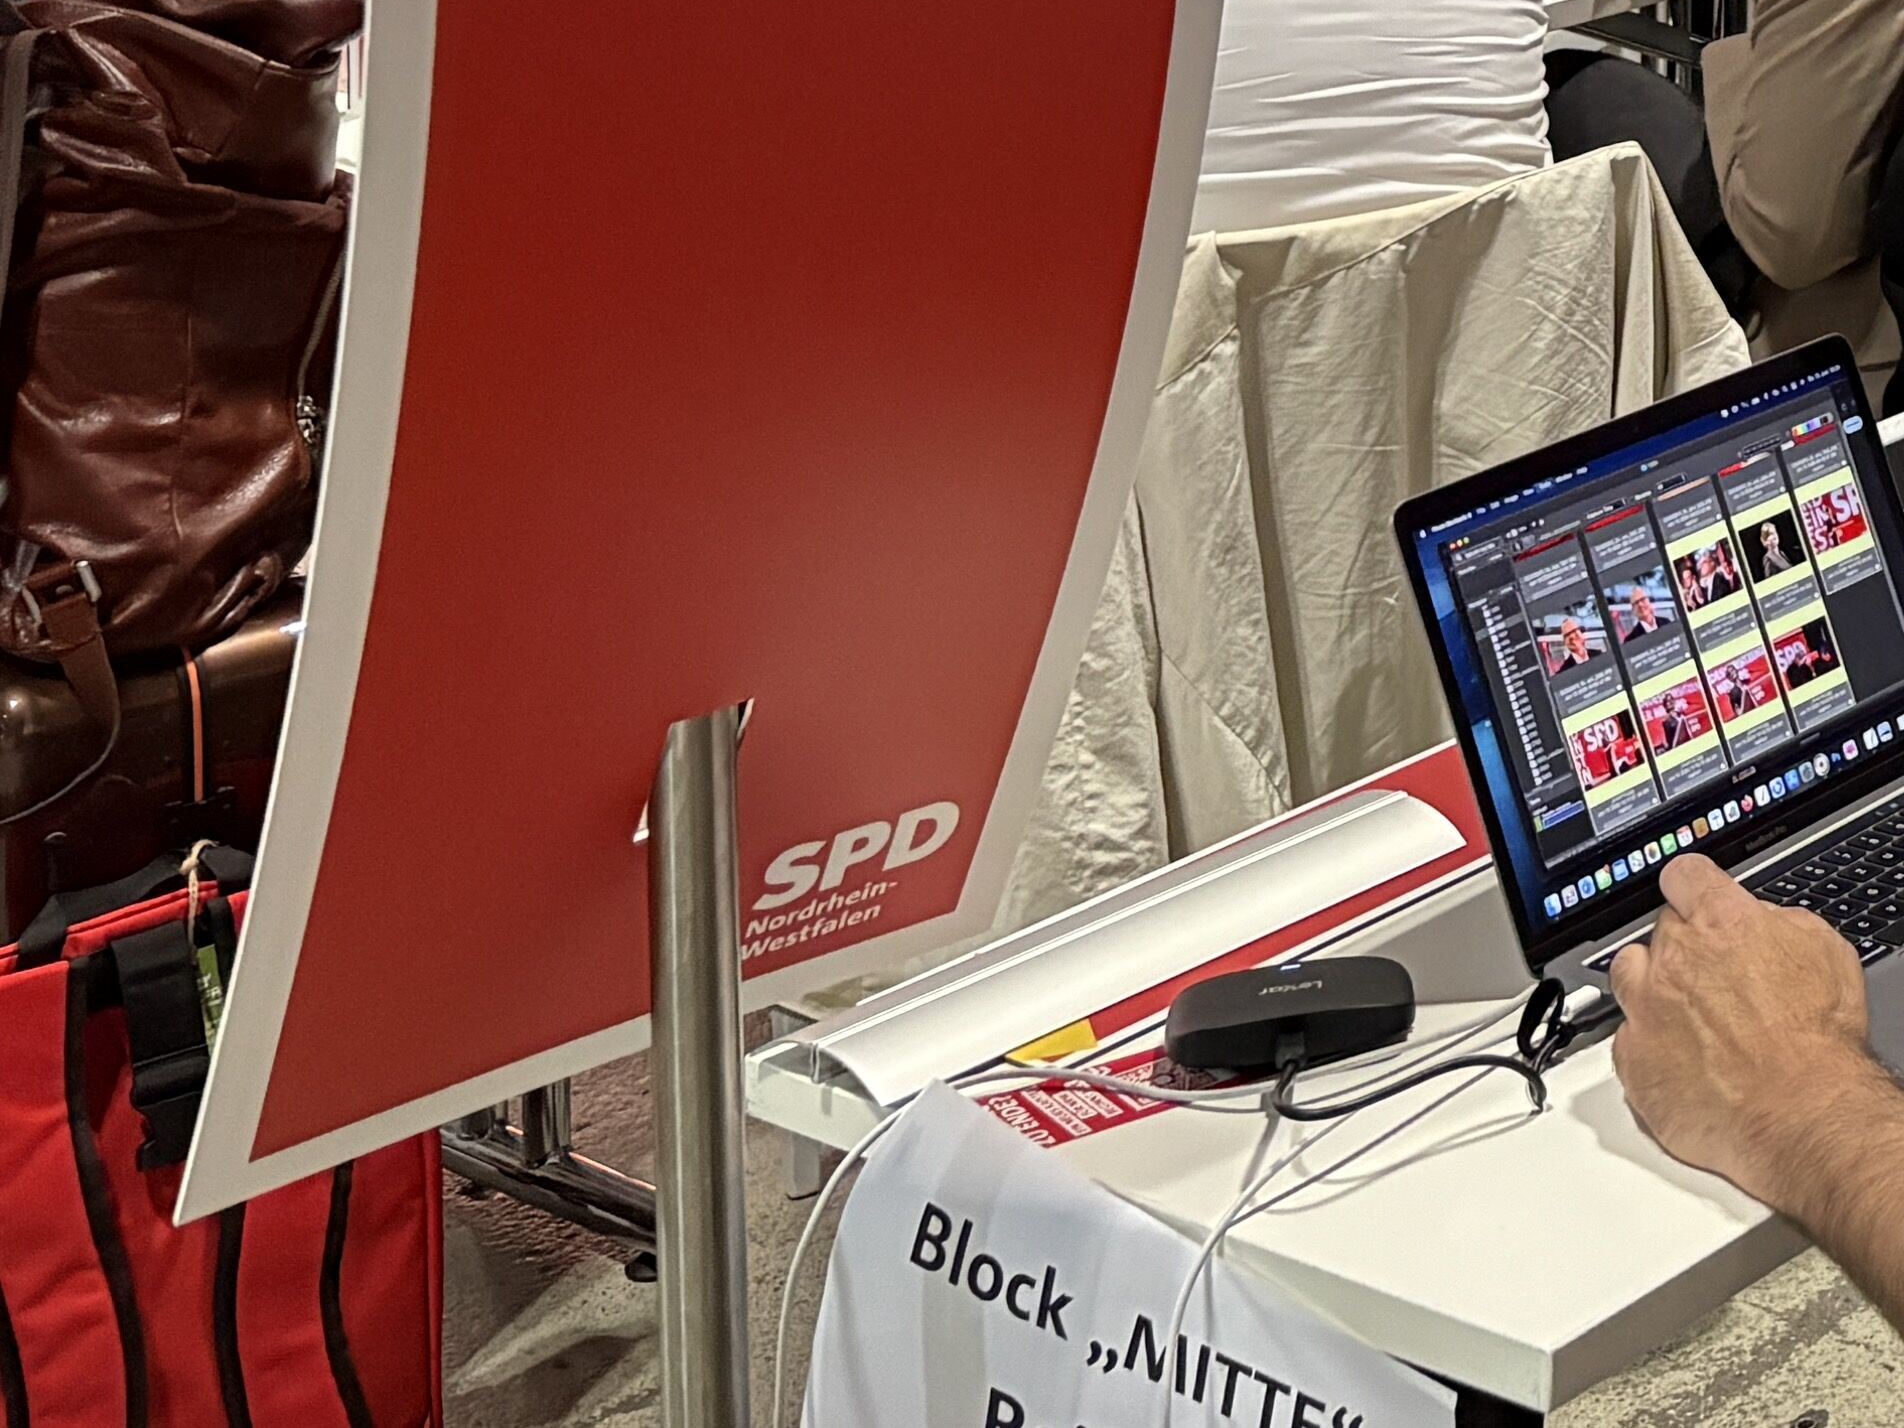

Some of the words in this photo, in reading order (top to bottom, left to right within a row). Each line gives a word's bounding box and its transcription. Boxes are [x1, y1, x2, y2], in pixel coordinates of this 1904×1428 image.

[752, 800, 961, 911] SPD
[740, 904, 882, 962] Westfalen
[744, 880, 899, 939] Nordrhein-
[908, 1200, 1074, 1342] Block
